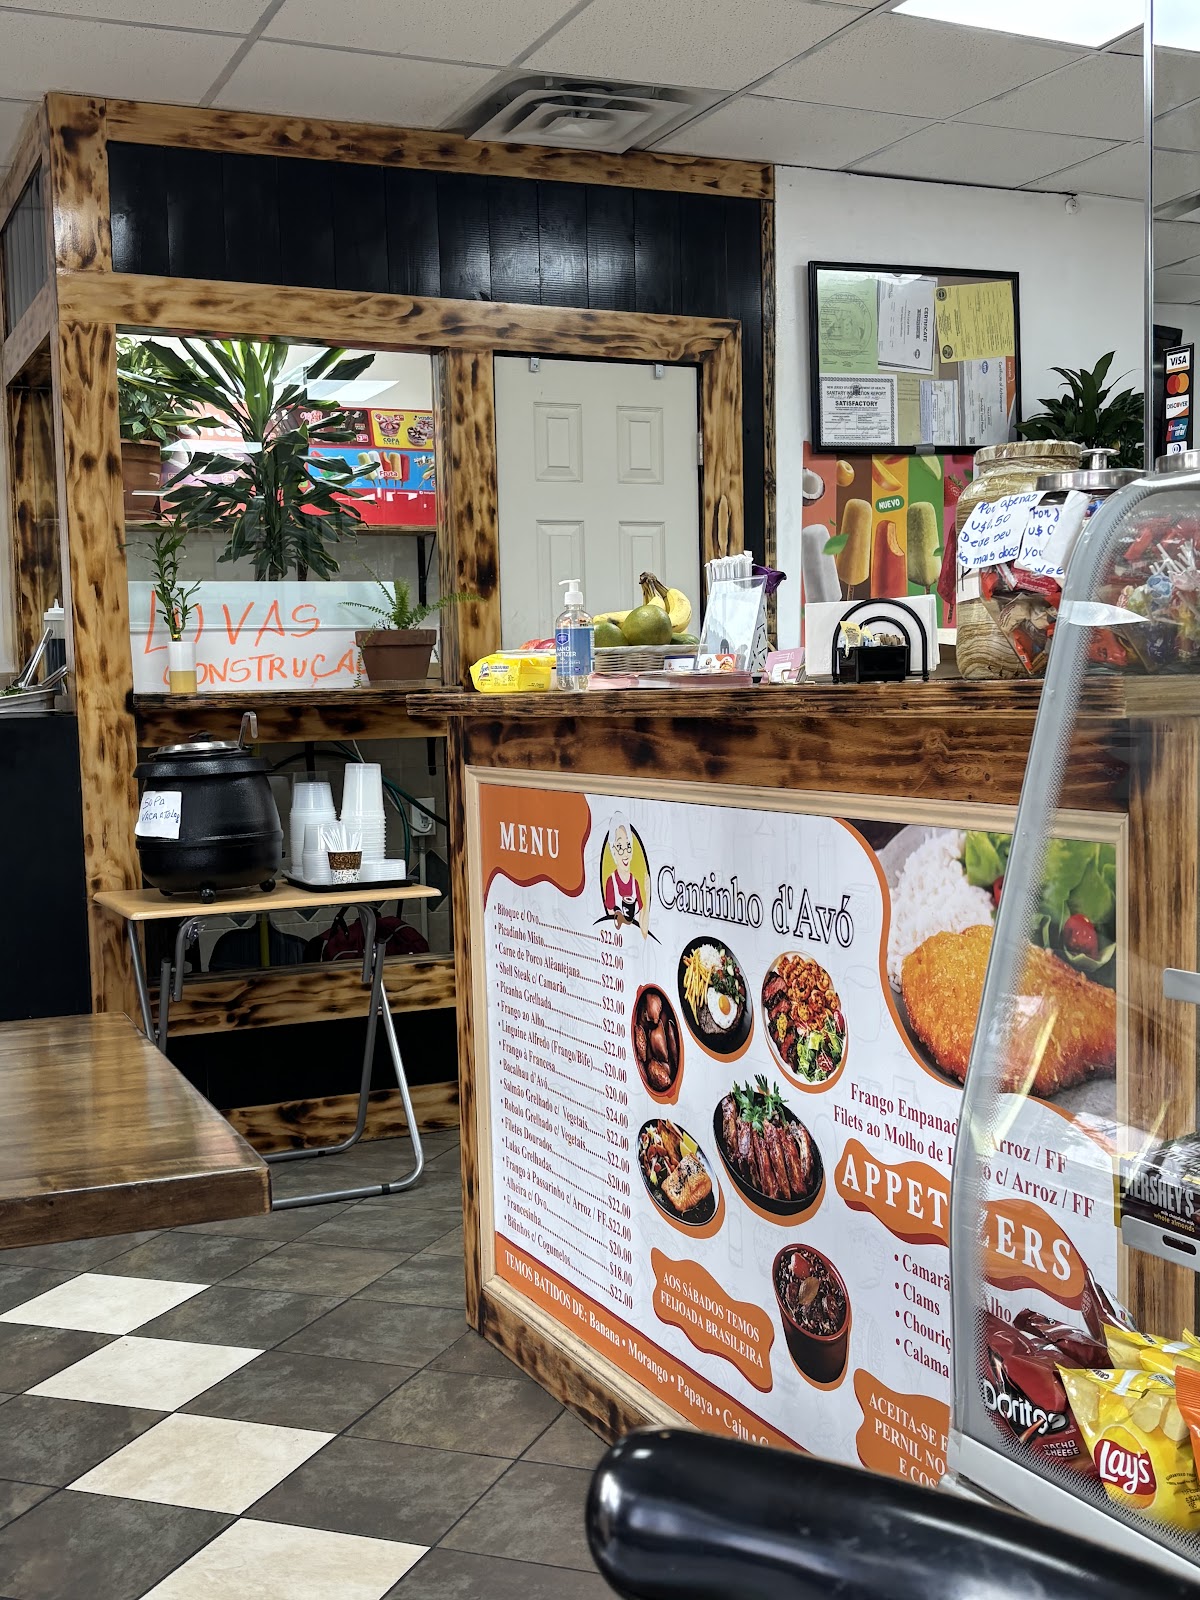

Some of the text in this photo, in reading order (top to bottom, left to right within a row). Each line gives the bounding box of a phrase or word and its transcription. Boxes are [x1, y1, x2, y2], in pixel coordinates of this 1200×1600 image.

[1170, 355, 1187, 366] VISA
[1167, 401, 1188, 410] DISCOVER
[878, 499, 901, 510] NUEVO
[500, 821, 559, 859] MENU
[497, 903, 520, 921] Bitoque
[526, 910, 540, 924] Ovo
[600, 929, 623, 947] $22.00
[657, 865, 854, 948] Cantinho d'Avó
[498, 922, 624, 970] Picadinho Misto $22.00
[498, 942, 517, 956] Carne
[517, 948, 525, 957] de
[525, 949, 543, 967] Porco
[601, 973, 624, 993] $22.00
[499, 961, 513, 977] Shell
[513, 967, 531, 982] Steak
[538, 974, 567, 995] Camarão
[602, 996, 625, 1015] $23.00
[500, 981, 626, 1038] Picanha Grelhada $22.00
[501, 1000, 626, 1060] Frango ao Alho $22.00
[501, 1020, 527, 1041] Linguine
[527, 1031, 550, 1050] Alfredo
[604, 1062, 627, 1083] $20.00
[502, 1039, 523, 1060] Frango
[528, 1050, 556, 1072] Francesa
[605, 1084, 628, 1106] $20.00
[503, 1078, 525, 1099] Salmão
[525, 1088, 553, 1111] Grelhado
[562, 1106, 589, 1130] Vegetais
[606, 1128, 629, 1151] $22.00
[504, 1097, 524, 1118] Robalo
[525, 1108, 553, 1133] Grelhado
[561, 1125, 587, 1151] Vegetais
[607, 1150, 630, 1174] $22.00
[605, 1106, 629, 1129] $24.00
[851, 1083, 894, 1116] Frango
[898, 1098, 959, 1136] Empanad
[1035, 1146, 1040, 1165] /
[1045, 1148, 1068, 1174] FF
[505, 1117, 630, 1196] Filetes Dourados $20.00
[505, 1136, 631, 1219] Lulas Grelhadas $22.00
[833, 1104, 863, 1132] Filets
[866, 1121, 881, 1138] ao
[884, 1123, 924, 1155] Molho
[928, 1140, 943, 1161] de
[996, 1166, 1008, 1187] c/
[1012, 1171, 1057, 1207] Arroz
[1062, 1189, 1068, 1209] /
[1072, 1192, 1094, 1218] FF
[506, 1155, 526, 1179] Frango
[532, 1169, 565, 1201] Passarinho
[572, 1196, 592, 1218] Arroz
[608, 1217, 631, 1242] $22.00
[1125, 1166, 1195, 1219] HERSHEY'S
[506, 1176, 527, 1201] Alheira
[534, 1192, 548, 1210] Ovo
[609, 1239, 632, 1264] $20.00
[507, 1194, 632, 1287] Francesinha $18.00
[1153, 1212, 1195, 1233] whole almonds
[507, 1214, 531, 1239] Bifinhos
[537, 1234, 571, 1266] Cogumelos
[610, 1284, 633, 1309] $22.00
[903, 1253, 950, 1292] Camarã
[663, 1272, 760, 1343] AOS SÁBADOS TEMOS
[903, 1282, 940, 1316] Clams
[505, 1250, 749, 1440] TEMOS BATIDOS DE: Banana Morango Papaya Caju
[660, 1290, 764, 1369] FEIJOADA BRASILEIRA
[903, 1310, 951, 1354] Chouriç
[903, 1338, 950, 1378] Calama
[868, 1392, 937, 1444] ACEITA-SE
[1042, 1439, 1075, 1449] NACHO
[874, 1418, 922, 1462] PERNIL
[925, 1453, 946, 1475] NO
[899, 1457, 939, 1488] E COS
[1045, 1447, 1079, 1457] CHEESE
[1101, 1440, 1150, 1494] Lay's
